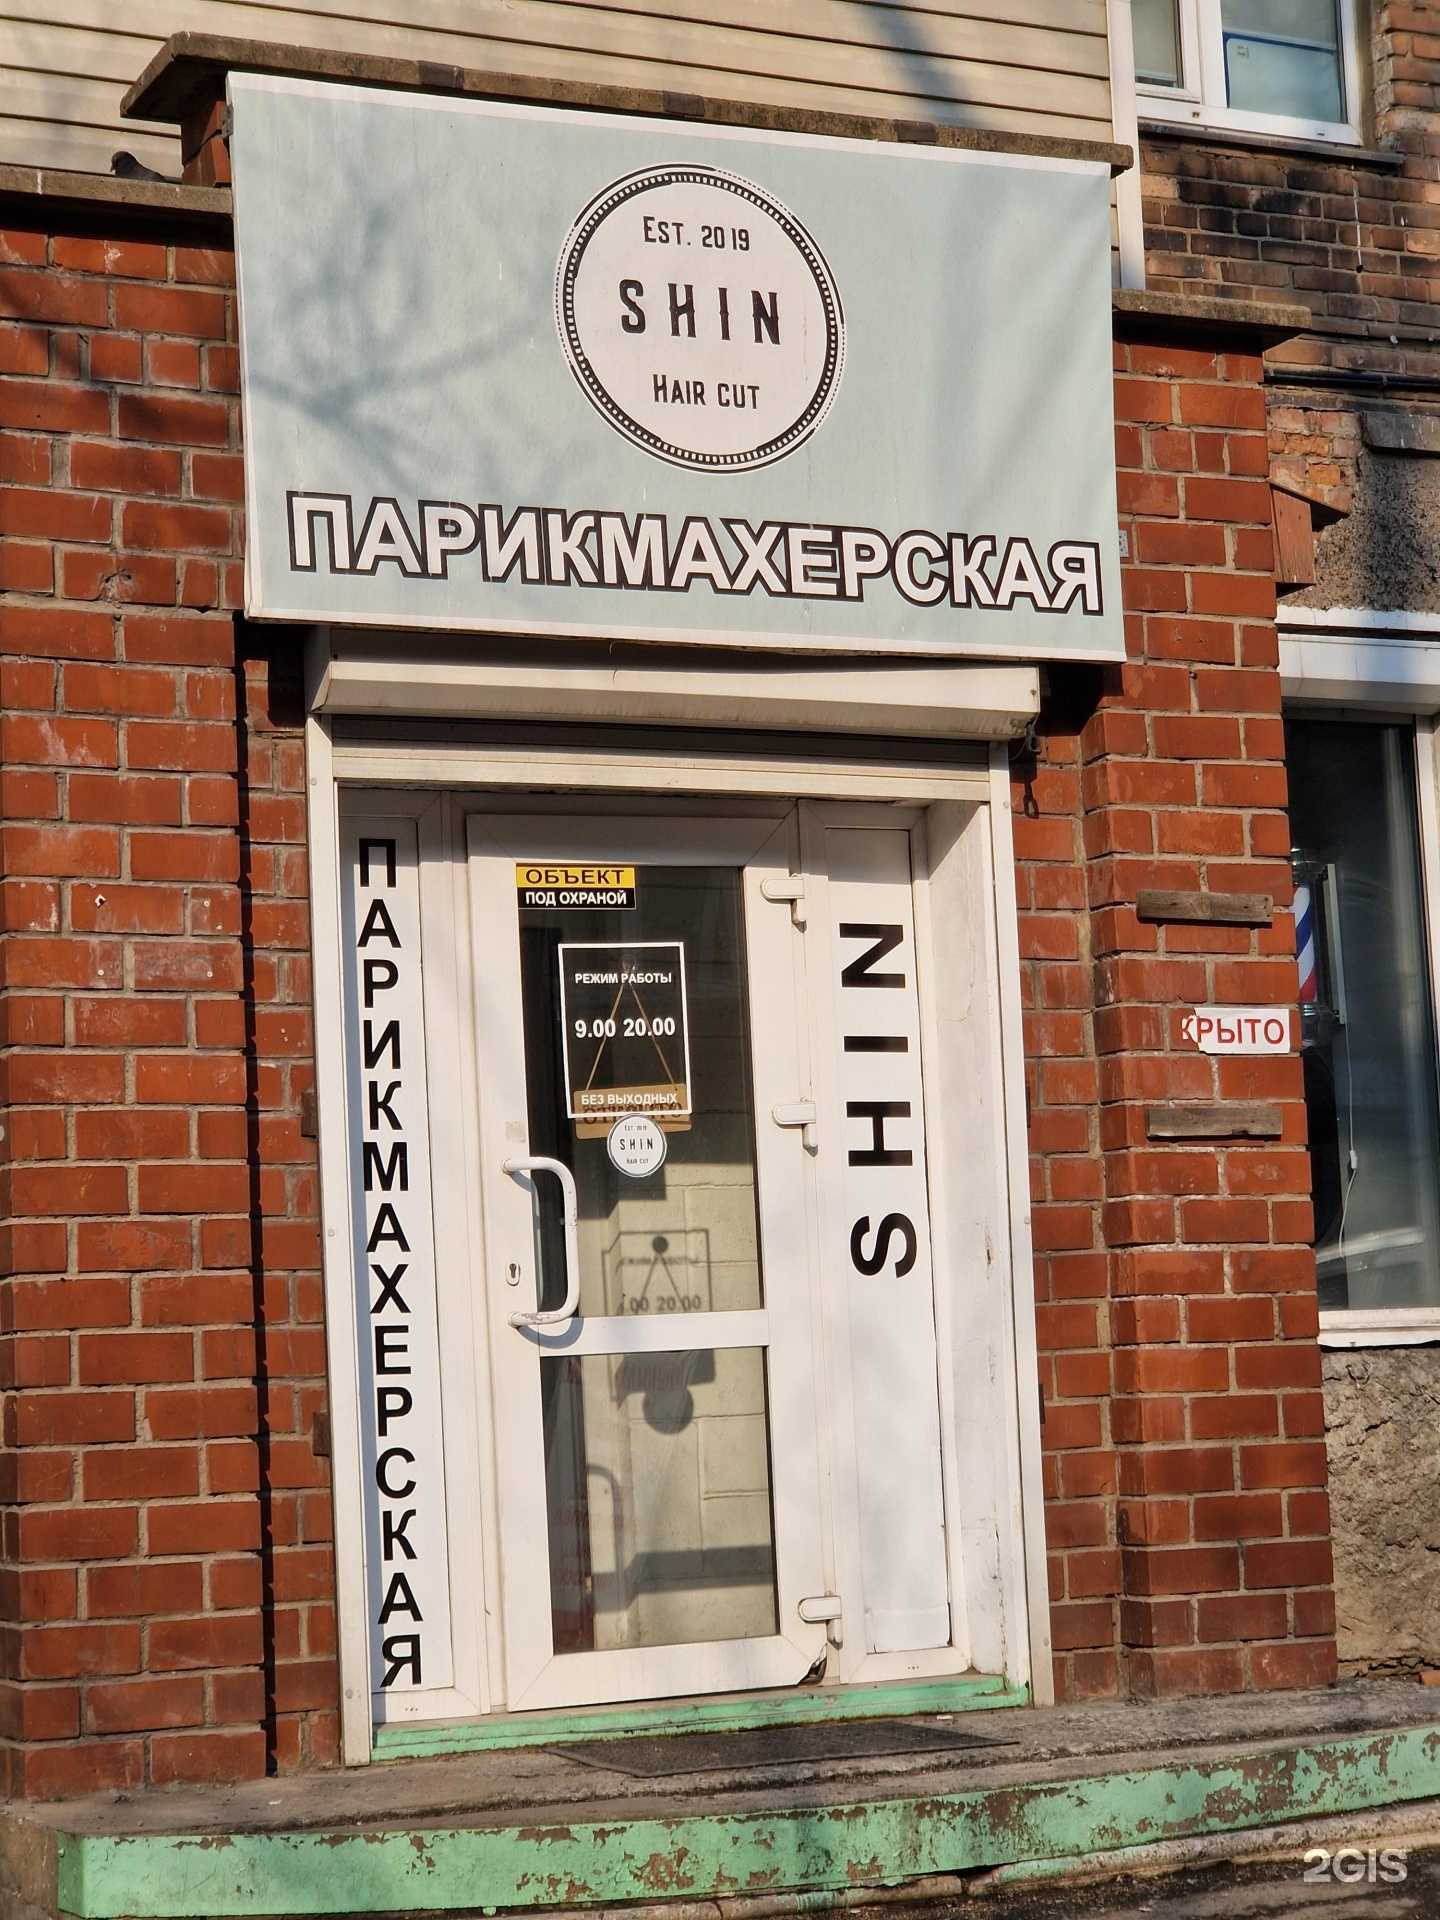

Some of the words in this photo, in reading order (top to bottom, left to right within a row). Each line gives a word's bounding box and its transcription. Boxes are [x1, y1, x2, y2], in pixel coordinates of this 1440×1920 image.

[701, 225, 750, 251] 2019
[618, 278, 780, 345] SHIN
[717, 382, 760, 410] CUT
[286, 490, 1103, 616] ПАРИКМАХЕРСКАЯ
[525, 869, 625, 885] ОБЪЕКТ
[525, 891, 557, 907] ПОД
[559, 889, 627, 905] ОХРАНОЙ
[575, 973, 618, 985] РЕЖИМ
[621, 972, 672, 984] РАБОТЫ
[575, 1019, 616, 1038] 9.00
[623, 1017, 676, 1037] 20.00
[581, 1094, 604, 1105] БЕЗ
[607, 1092, 678, 1105] ВЫХОДНЫХ
[839, 922, 918, 1278] SHIN
[619, 1138, 654, 1151] SHIN
[357, 838, 424, 1689] ПАРИКМАХЕРСКАЯ
